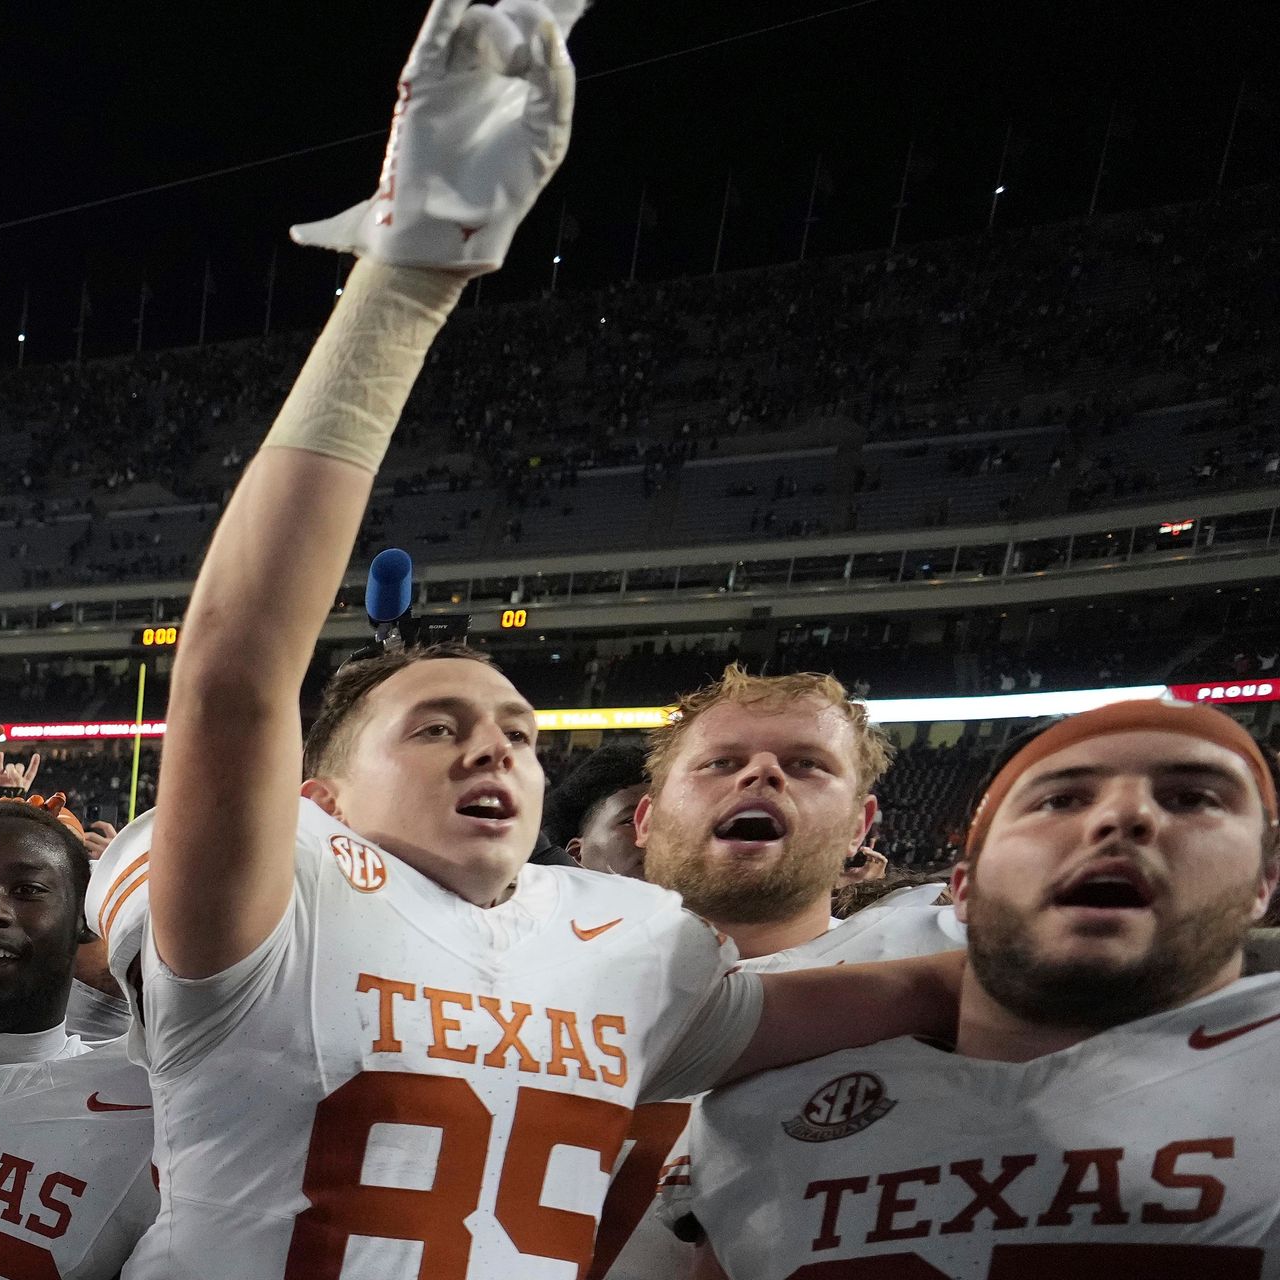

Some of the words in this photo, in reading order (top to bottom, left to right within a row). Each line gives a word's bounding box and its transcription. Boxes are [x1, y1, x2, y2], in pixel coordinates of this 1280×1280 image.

[1197, 683, 1273, 700] PROUD
[329, 834, 387, 893] SEC
[355, 972, 628, 1088] TEXAS
[804, 1071, 884, 1127] SEC
[803, 1137, 1236, 1252] TEXAS
